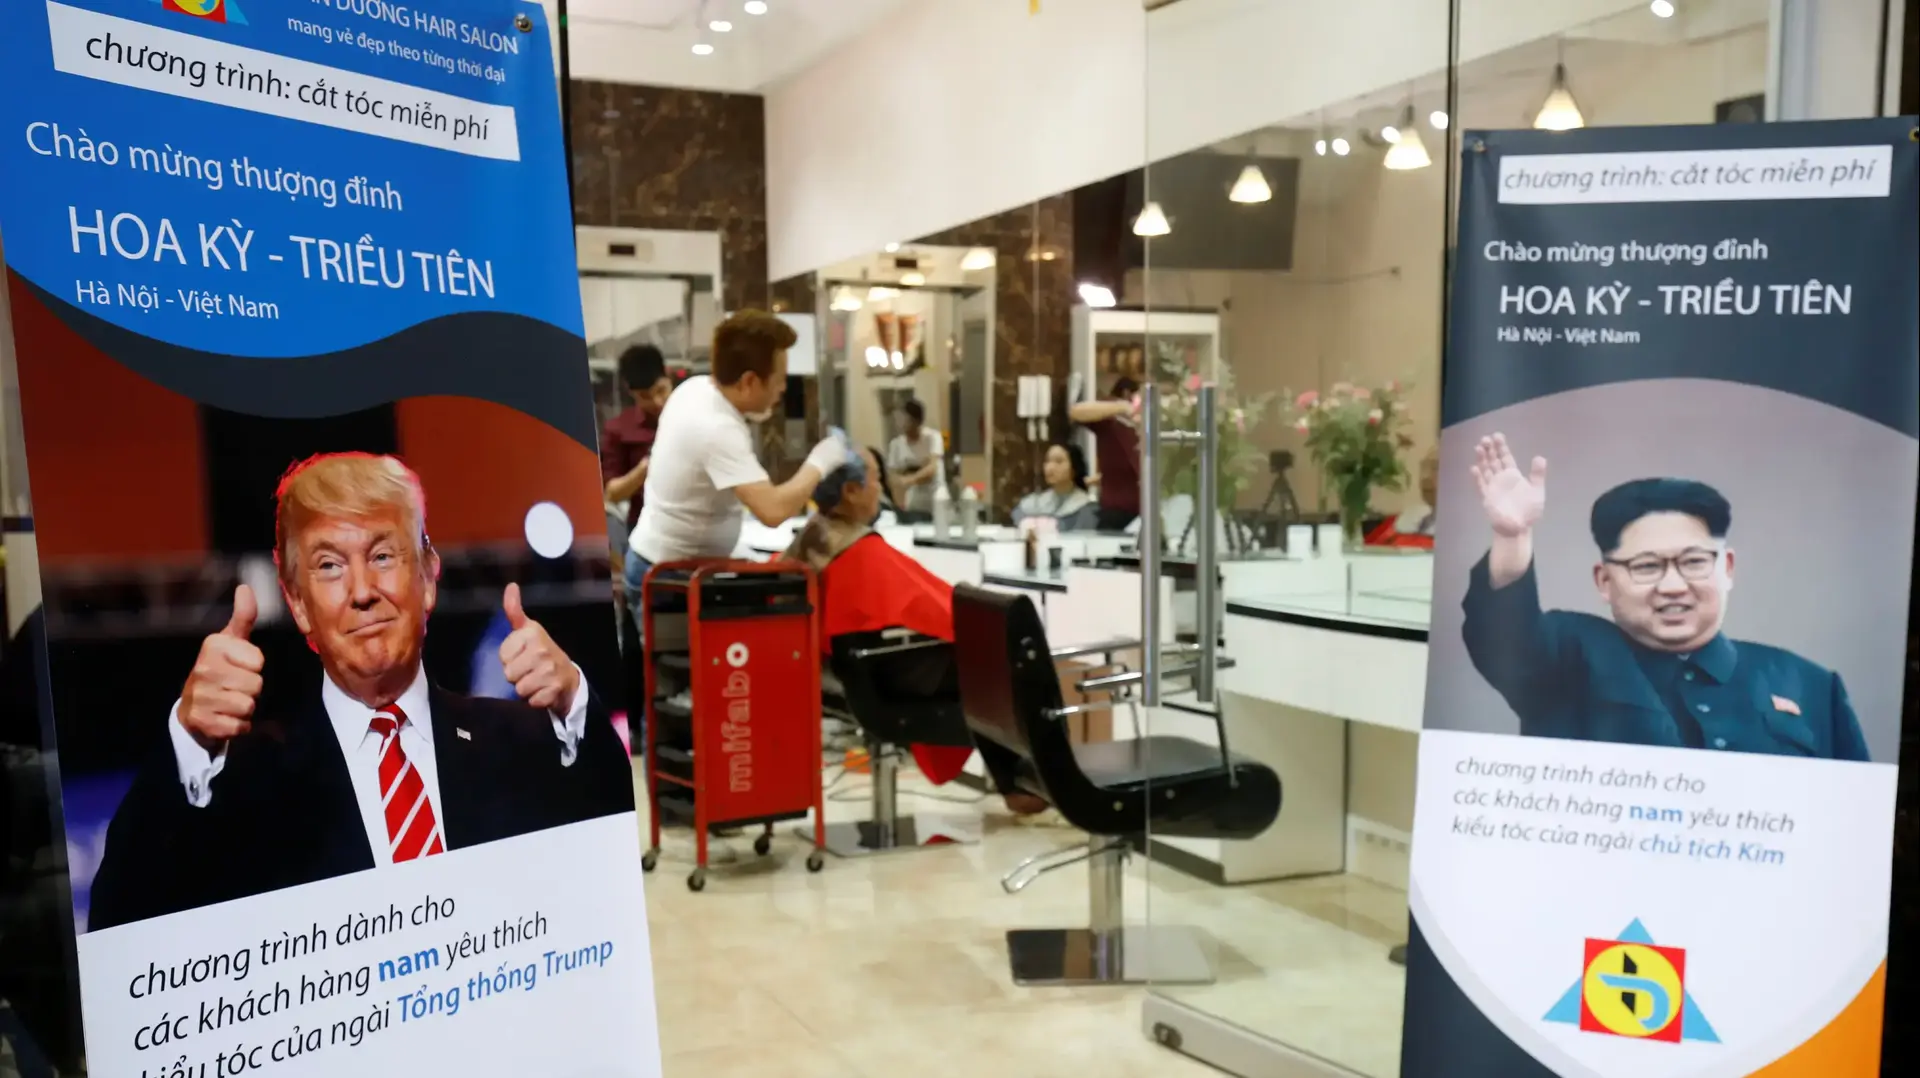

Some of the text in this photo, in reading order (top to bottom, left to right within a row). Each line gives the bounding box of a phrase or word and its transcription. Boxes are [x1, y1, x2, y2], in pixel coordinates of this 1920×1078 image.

[288, 17, 506, 86] mang vẻ đẹp theo từng thời đại
[414, 10, 458, 40] HAIR
[461, 23, 518, 55] SALON
[86, 32, 490, 142] chương trình: cắt tóc miễn phí
[26, 120, 403, 212] Chào mừng thượng đỉnh
[1504, 169, 1594, 192] chương
[1601, 164, 1665, 188] trình:
[1670, 165, 1708, 185] cắt
[1715, 162, 1754, 184] tóc
[1830, 158, 1878, 186] phí
[67, 206, 188, 267] HOA
[198, 217, 255, 273] KỲ
[288, 232, 405, 290] TRIỀU
[412, 247, 496, 299] TIÊN
[1484, 238, 1769, 267] Chào mừng thượng đỉnh
[76, 279, 111, 306] Hà
[118, 285, 160, 312] Nội
[177, 288, 224, 317] Việt
[228, 295, 280, 320] Nam
[1500, 285, 1576, 315] HOA
[1585, 281, 1631, 315] KỲ
[1658, 277, 1760, 315] TRIỀU
[1768, 280, 1852, 315] TIÊN
[1497, 327, 1520, 343] Hà
[1523, 328, 1553, 344] Nội
[1564, 327, 1598, 346] Việt
[1600, 329, 1640, 344] Nam
[721, 641, 752, 793] mifabo
[1454, 757, 1706, 794] chương trình dành cho
[1453, 788, 1796, 834] các khách hàng nam yêu thích
[1500, 824, 1534, 842] tóc
[1538, 828, 1580, 846] của
[1583, 832, 1636, 853] ngài
[1638, 835, 1682, 854] chủ
[1687, 838, 1733, 861] tịch
[128, 894, 456, 1000] chương trình dành cho
[133, 911, 549, 1051] các khách hàng nam yêu thích
[215, 1043, 263, 1078] tóc
[270, 1026, 323, 1062] của
[329, 1000, 391, 1047] ngài
[396, 984, 460, 1024] Tổng
[466, 961, 538, 1000] thống
[543, 941, 614, 976] Trump
